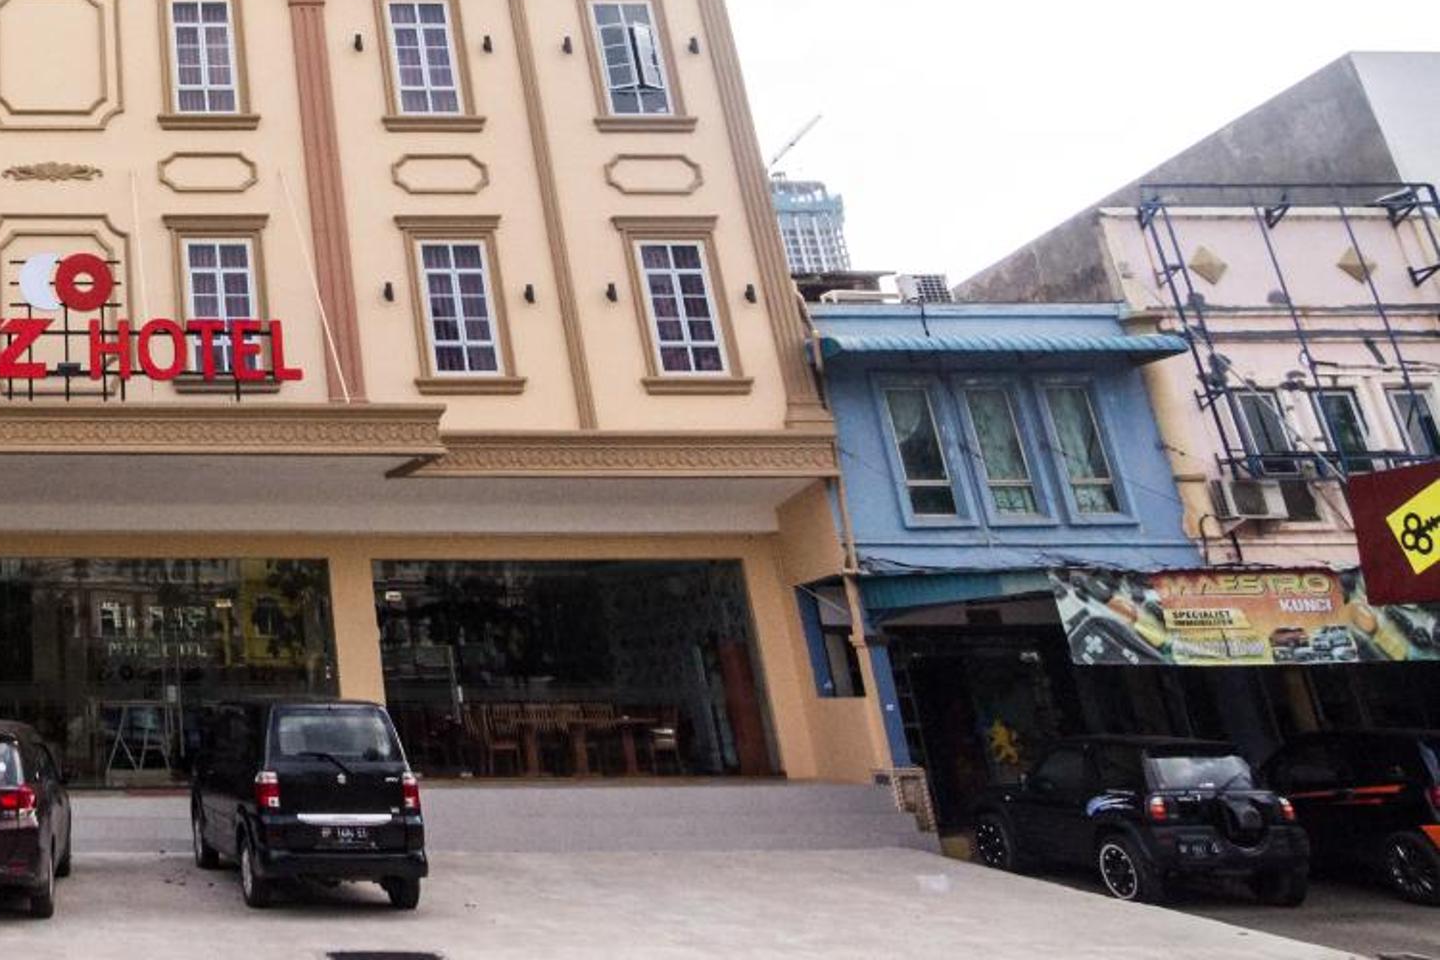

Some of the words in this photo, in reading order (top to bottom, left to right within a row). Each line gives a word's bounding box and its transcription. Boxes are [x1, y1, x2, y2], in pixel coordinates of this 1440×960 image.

[89, 318, 303, 382] HOTEL
[1163, 573, 1333, 597] MAESTRO
[1279, 597, 1333, 612] KUNCI
[1172, 610, 1231, 619] SPECIALIST
